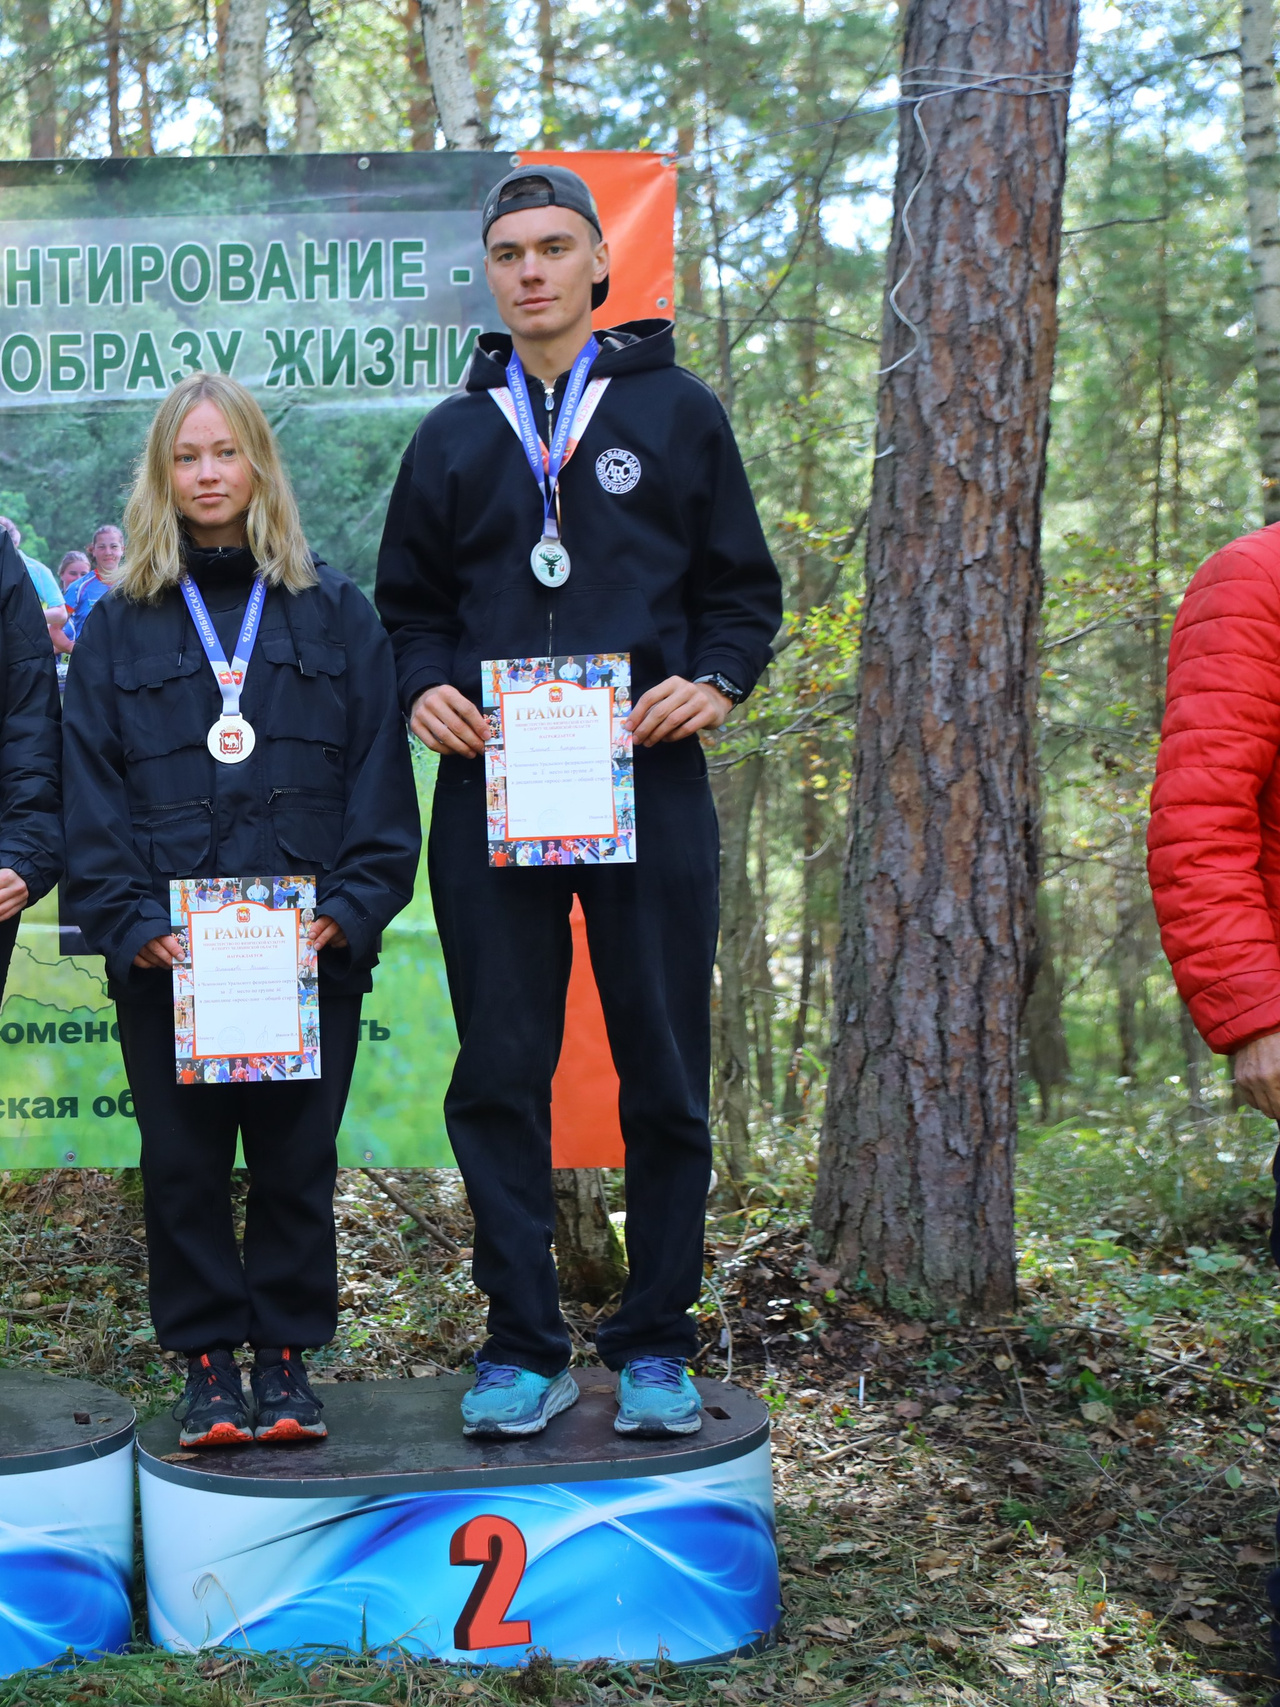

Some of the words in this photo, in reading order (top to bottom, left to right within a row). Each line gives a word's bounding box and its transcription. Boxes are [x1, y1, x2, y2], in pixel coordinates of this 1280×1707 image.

[0, 329, 244, 395] ОБРАЗУ
[265, 325, 483, 389] ЖИЗНИ
[564, 356, 591, 416] ЧЕЛЯБИНСКАЯ
[516, 400, 540, 467] ЧЕЛЯБИНСКАЯ
[552, 417, 570, 459] ОБЛАСТЬ
[187, 586, 215, 647] ЧЕЛЯБИНСКАЯ
[242, 602, 259, 643] ОБЛАСТЬ
[514, 703, 598, 720] ГРАМОТА
[203, 924, 284, 940] ГРАМОТА
[450, 1514, 532, 1650] 2
